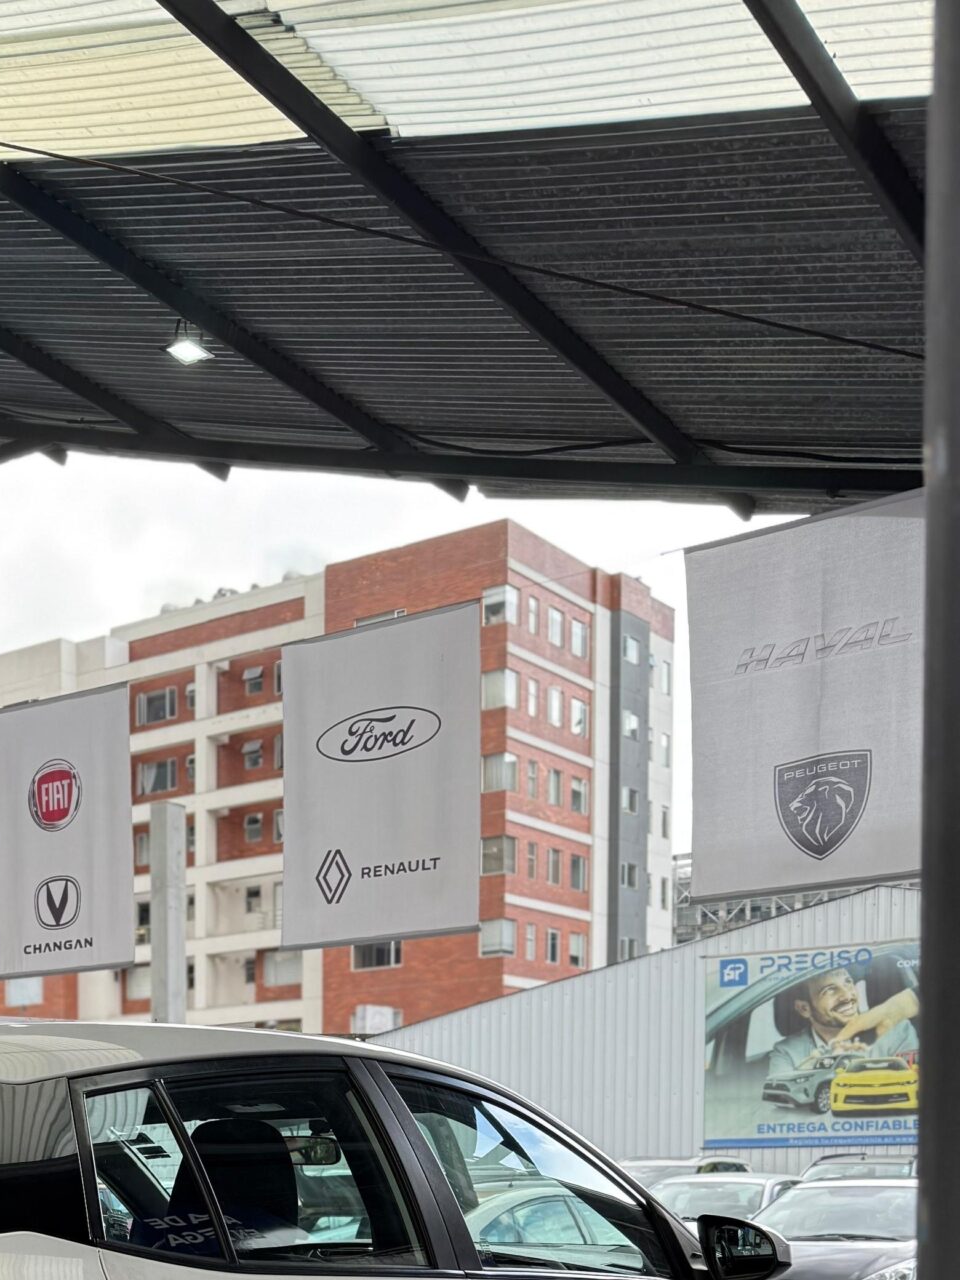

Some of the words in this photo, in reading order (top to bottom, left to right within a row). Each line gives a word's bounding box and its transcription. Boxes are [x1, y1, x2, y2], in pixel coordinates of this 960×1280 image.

[735, 616, 913, 676] HAVAL
[341, 714, 416, 756] Ford
[784, 759, 862, 781] PEUGEOT
[41, 779, 71, 813] FIAT
[361, 857, 441, 879] RENAULT
[23, 937, 94, 955] CHANGAN
[760, 948, 872, 974] PRECISO
[757, 1122, 828, 1135] ENTREGA
